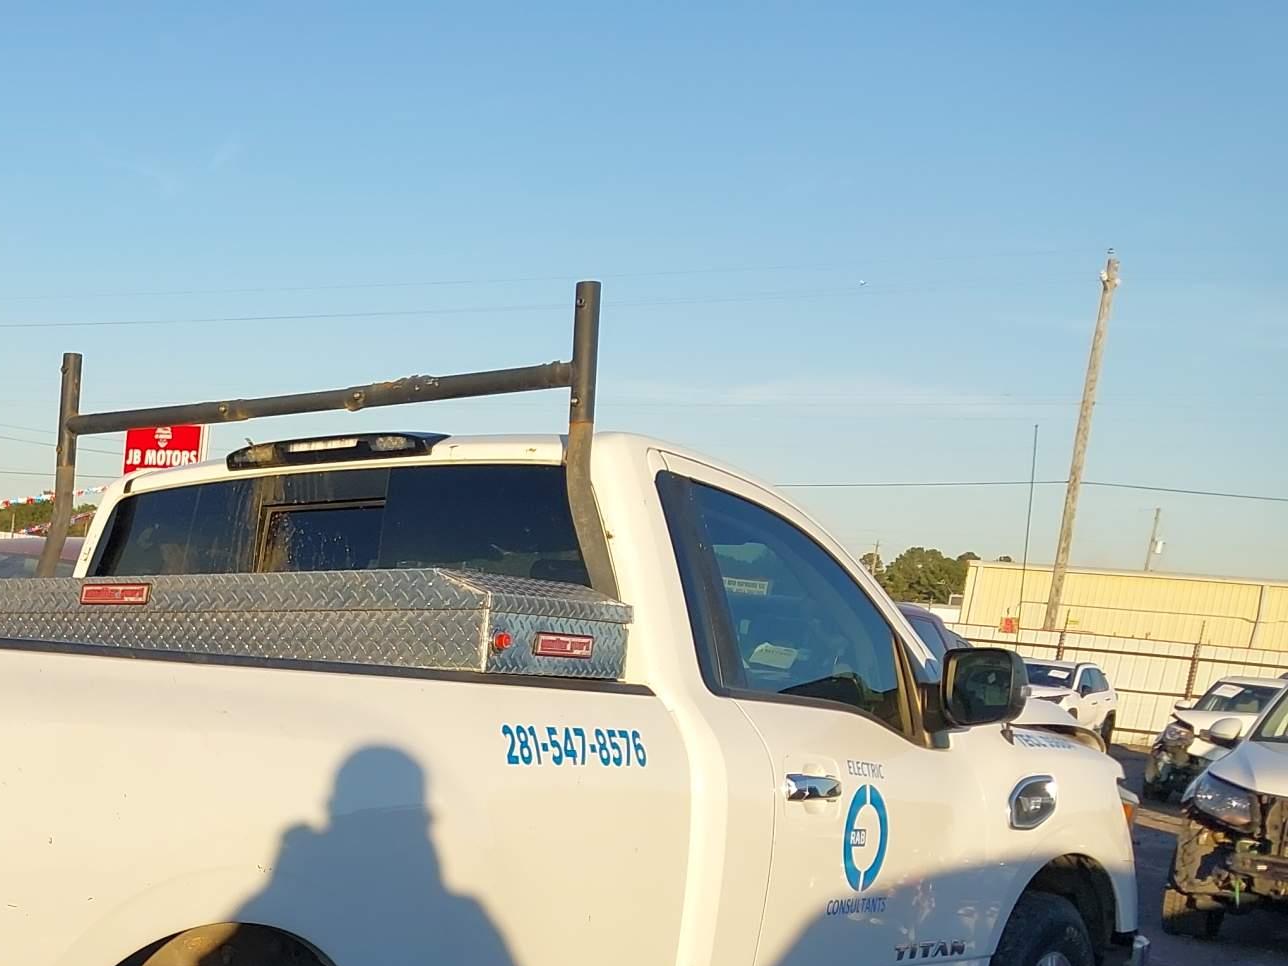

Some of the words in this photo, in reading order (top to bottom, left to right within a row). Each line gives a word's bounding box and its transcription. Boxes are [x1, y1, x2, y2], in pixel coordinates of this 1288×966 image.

[126, 448, 142, 466] JB
[144, 449, 197, 466] MOTORS
[501, 723, 647, 768] 281-547-8576
[847, 759, 884, 779] ELECTRIC
[850, 830, 866, 846] RAB
[826, 897, 887, 917] CONSULTANTS
[894, 939, 966, 961] TITAN
